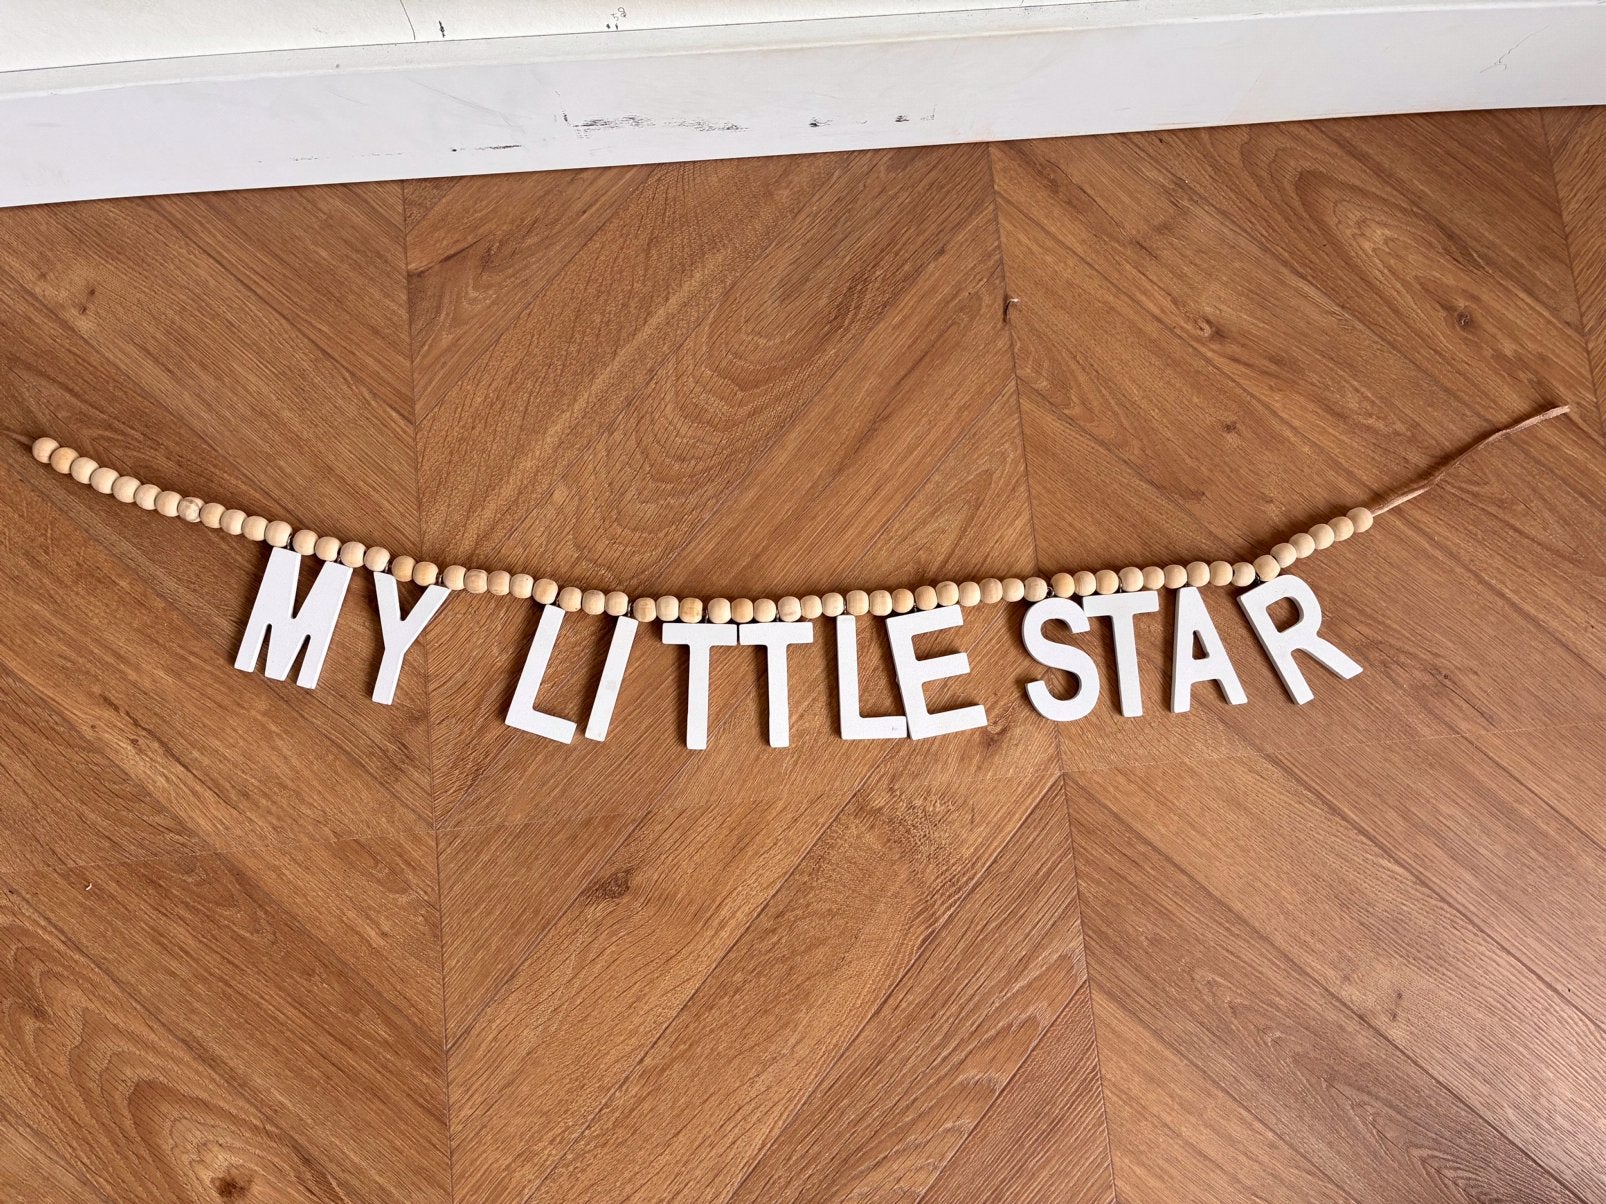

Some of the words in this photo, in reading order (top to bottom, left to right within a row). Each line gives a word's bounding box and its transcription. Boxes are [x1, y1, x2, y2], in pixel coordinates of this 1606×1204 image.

[234, 546, 452, 705] MY
[504, 604, 988, 750] LITTLE
[1022, 574, 1364, 722] STAR
